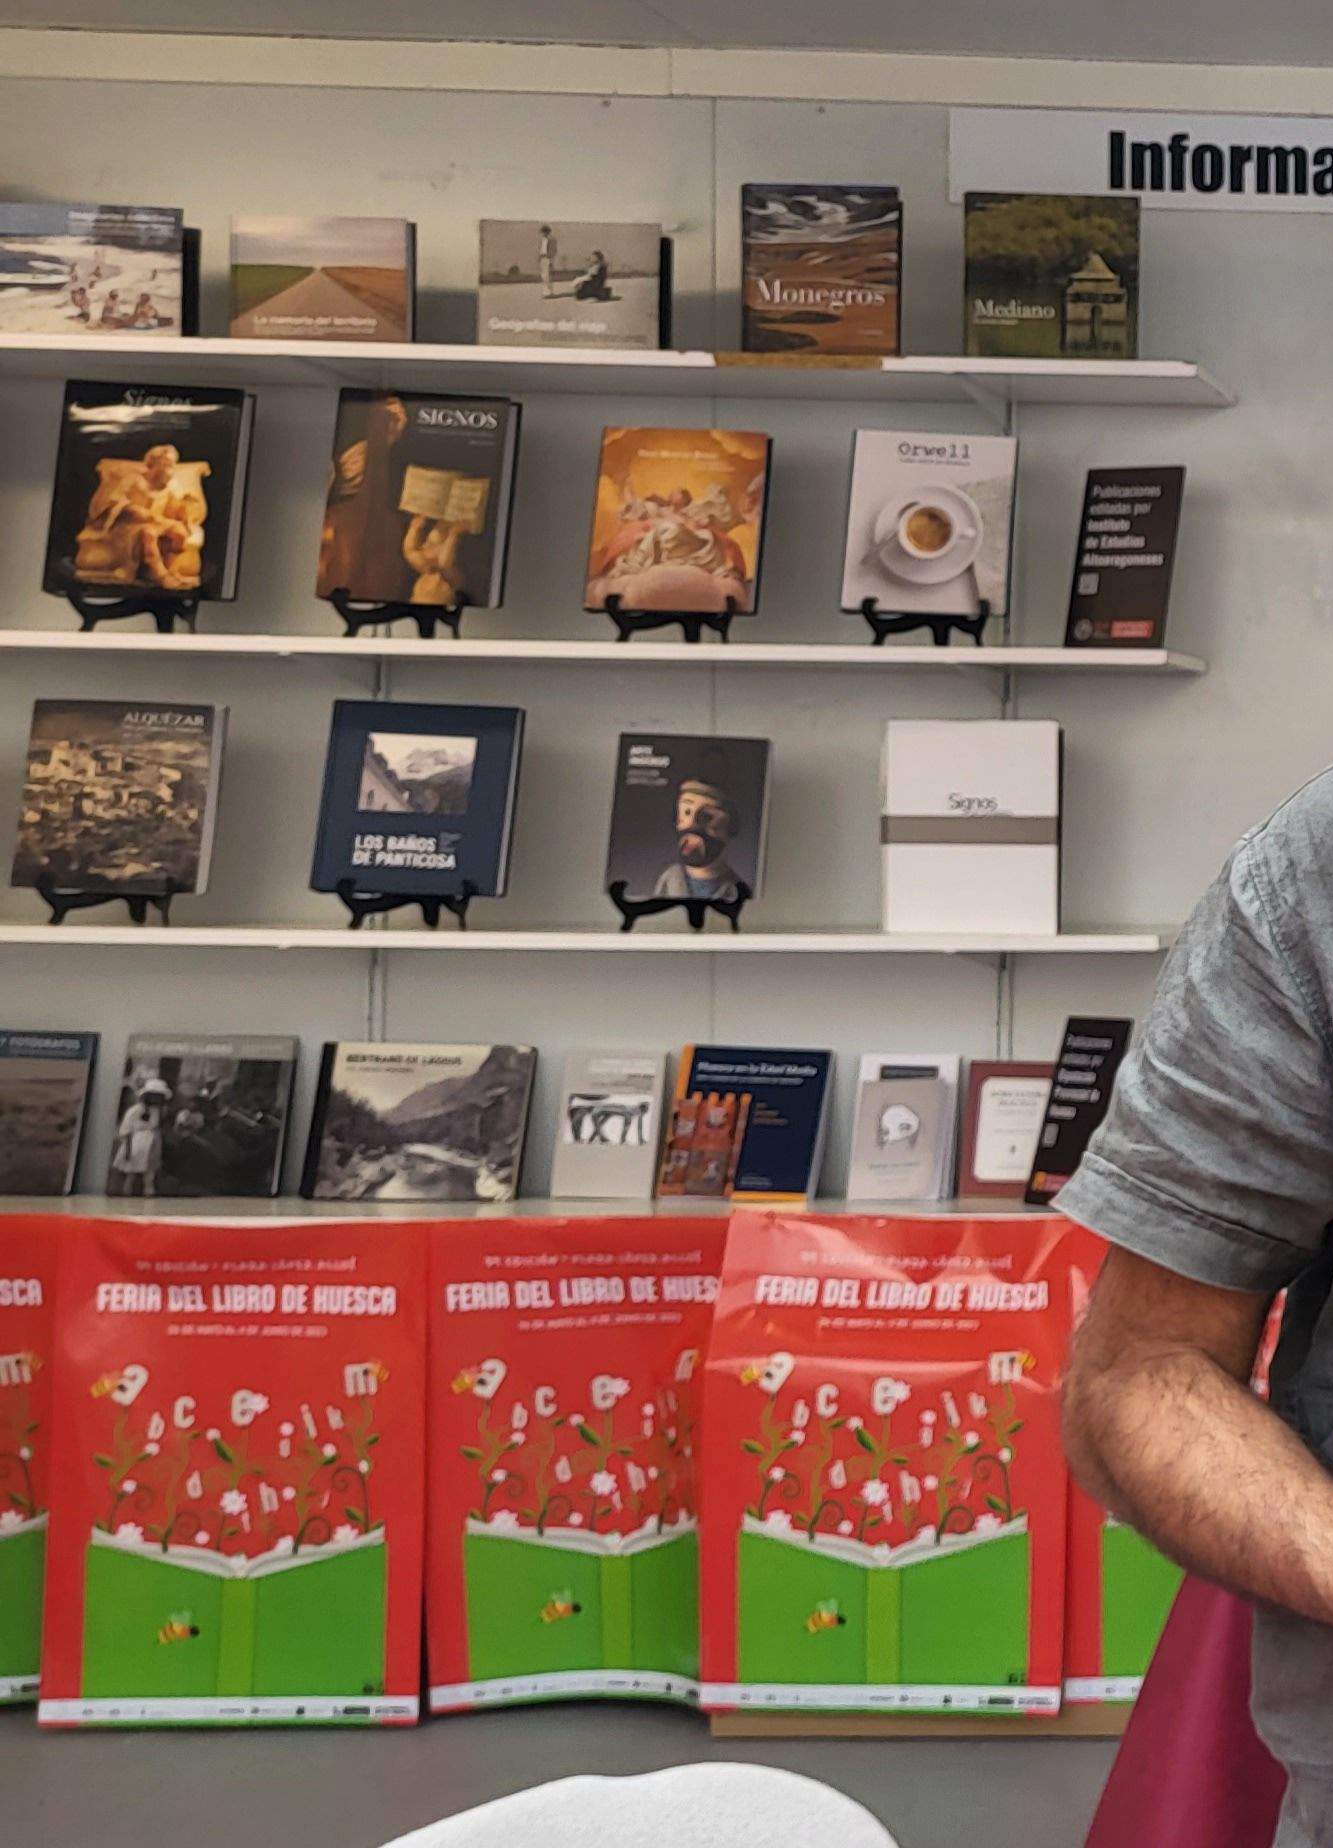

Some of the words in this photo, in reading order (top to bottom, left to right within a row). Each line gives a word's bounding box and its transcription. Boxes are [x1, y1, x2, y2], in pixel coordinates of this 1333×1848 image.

[759, 278, 886, 311] Monegros
[975, 298, 1056, 319] Mediano
[417, 409, 498, 428] SIGNOS
[898, 441, 970, 458] Orwell
[1093, 485, 1162, 498] Publicaciones
[355, 833, 385, 851] LOS
[353, 850, 371, 867] DE
[97, 1282, 162, 1313] FERIA
[167, 1284, 208, 1313] DEL
[211, 1283, 276, 1314] LIBRO
[280, 1283, 309, 1314] DE
[313, 1285, 397, 1316] HUESCA
[446, 1281, 511, 1312] FERIA
[514, 1279, 555, 1309] DEL
[559, 1276, 625, 1307] LIBRO
[629, 1276, 660, 1304] DE
[755, 1274, 819, 1306] FERIA
[821, 1277, 862, 1309] DEL
[865, 1279, 934, 1311] LIBRO
[934, 1281, 966, 1312] DE
[966, 1280, 1049, 1313] HUESCA
